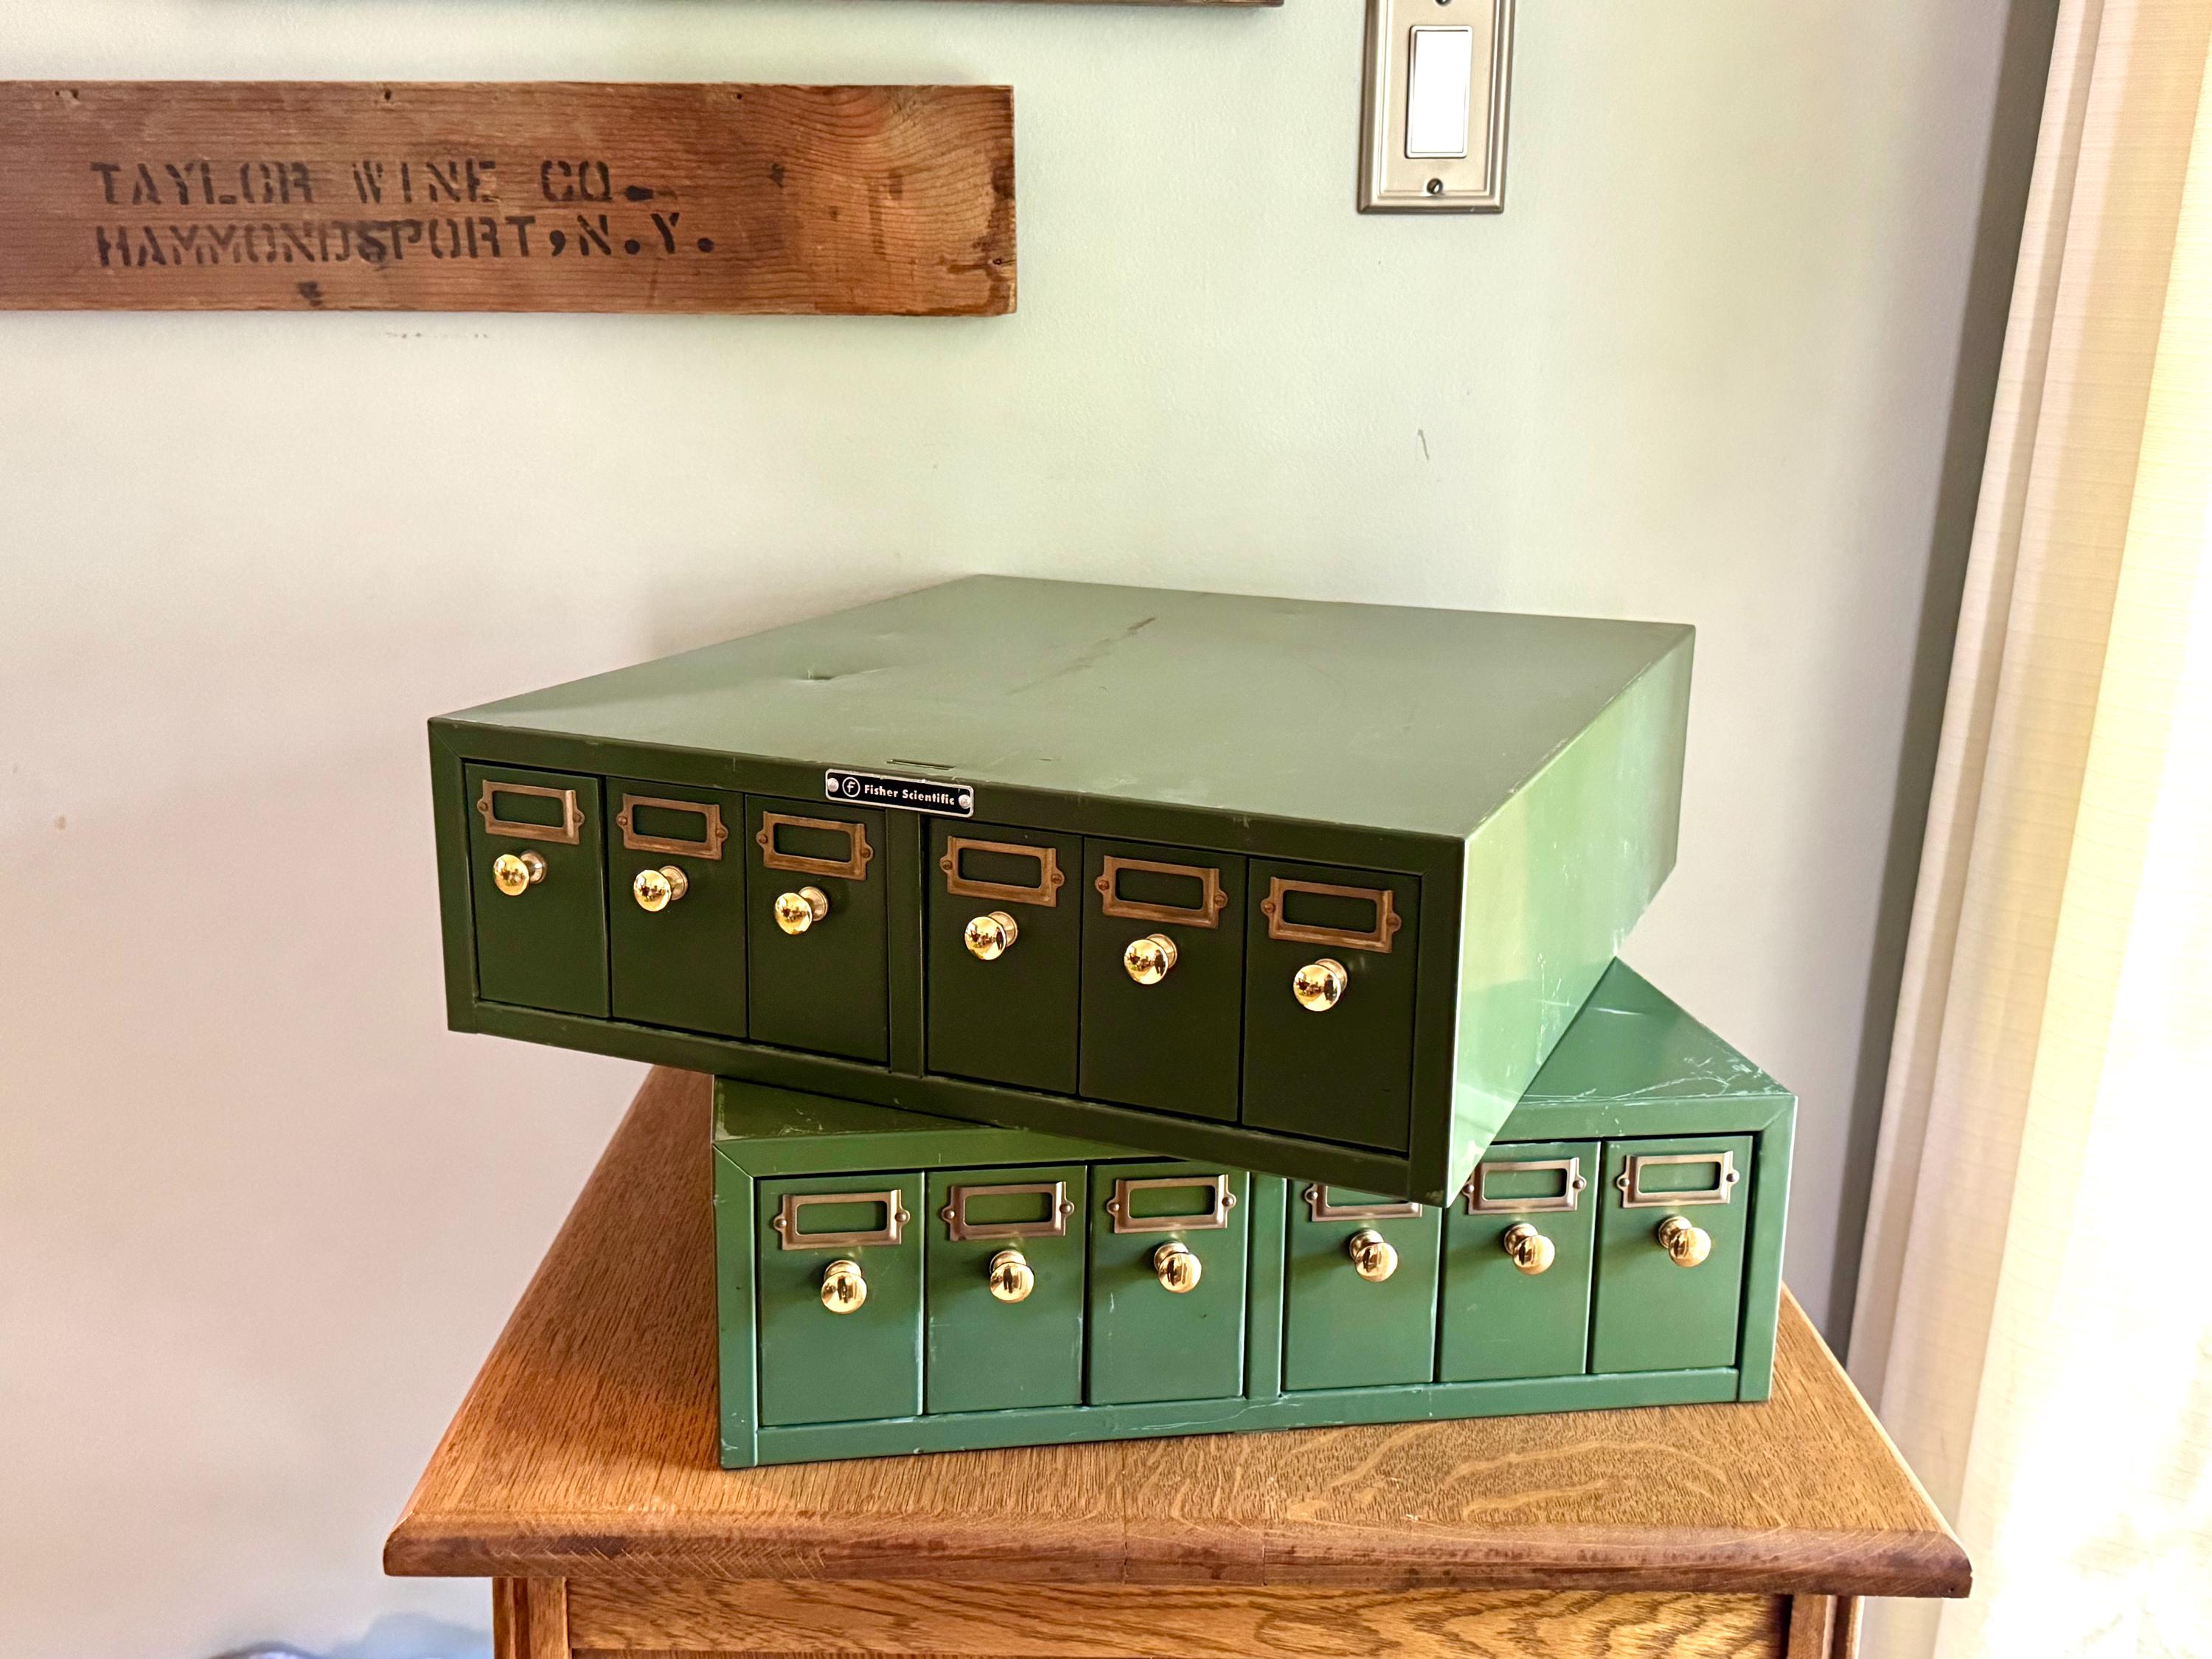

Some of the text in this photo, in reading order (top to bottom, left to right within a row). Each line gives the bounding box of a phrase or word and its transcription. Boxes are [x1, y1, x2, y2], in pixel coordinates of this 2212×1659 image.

[90, 161, 313, 205] TAYLOR
[352, 158, 500, 204] WINE
[864, 784, 899, 798] Fisher
[902, 789, 955, 806] Scientific
